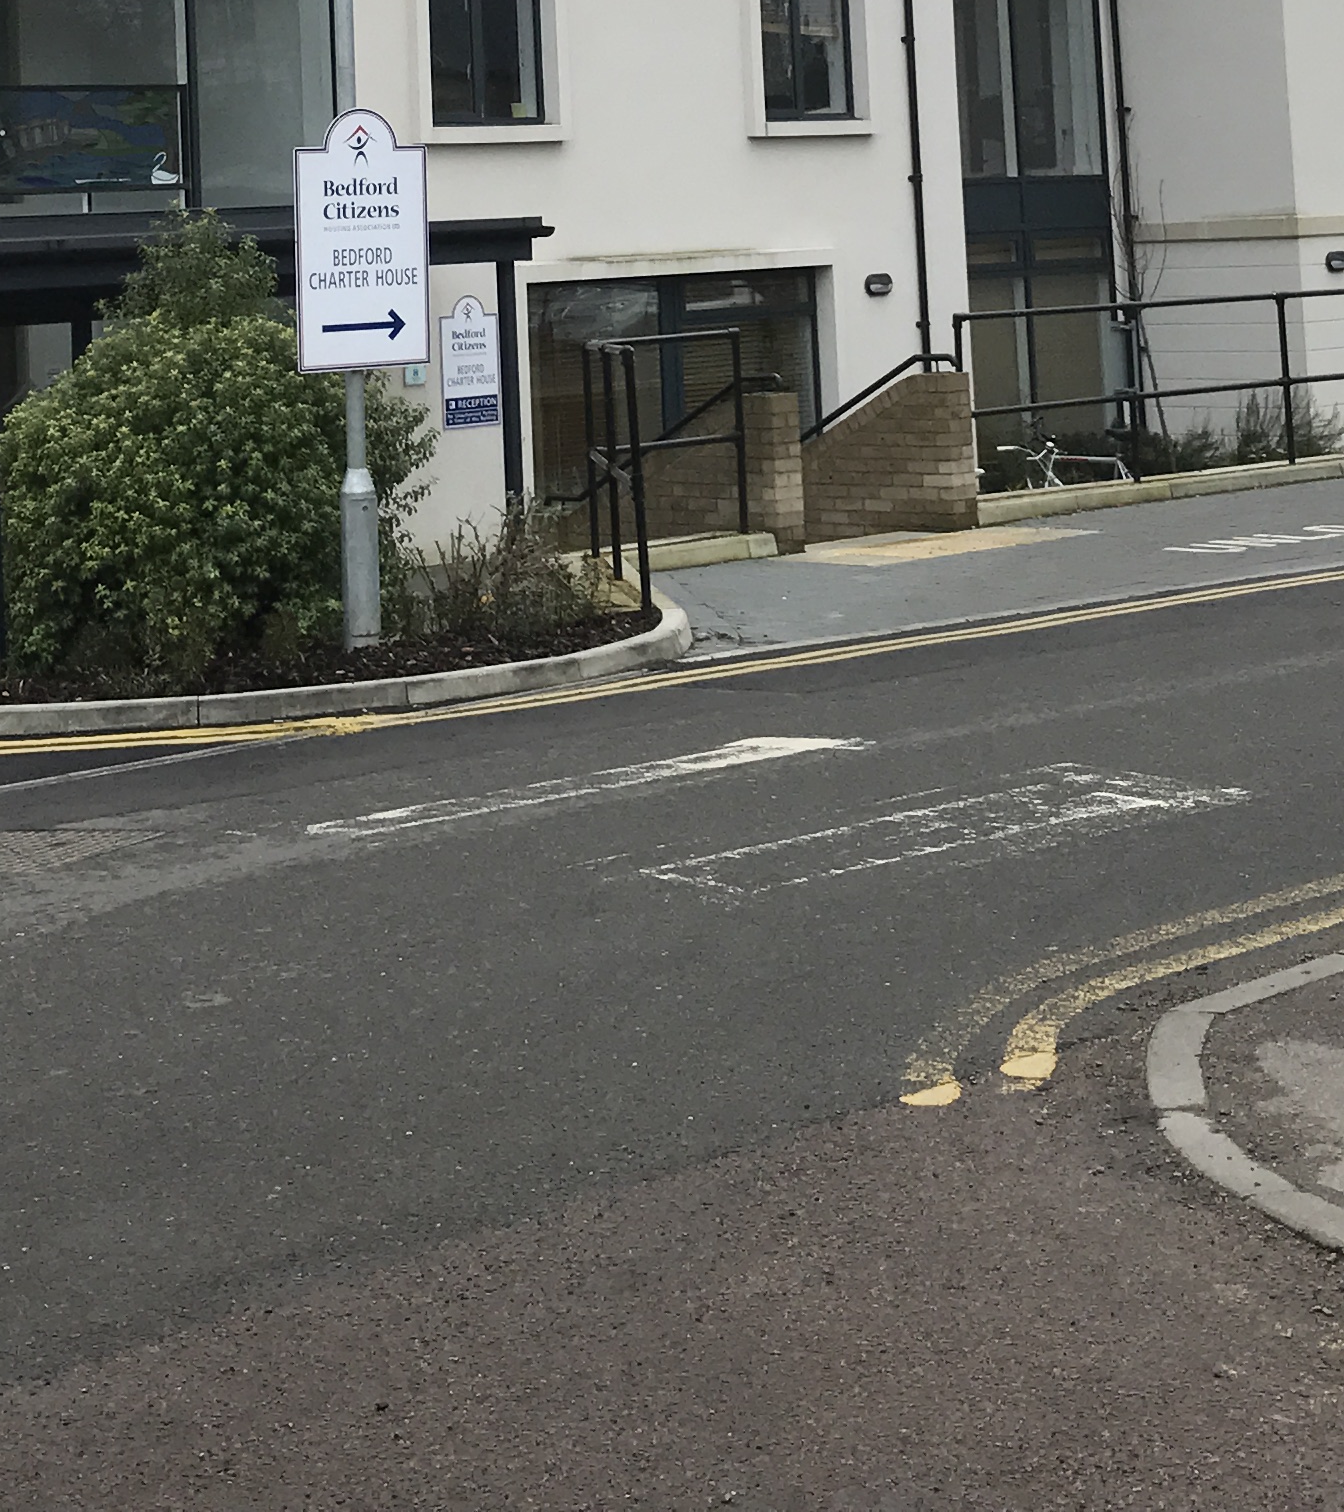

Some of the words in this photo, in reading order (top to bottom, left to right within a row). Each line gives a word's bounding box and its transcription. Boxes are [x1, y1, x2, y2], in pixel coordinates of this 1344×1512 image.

[323, 176, 399, 197] Bedford
[323, 201, 400, 220] Citizens
[333, 247, 393, 267] BEDFORD
[309, 270, 369, 290] CHARTER
[376, 267, 418, 286] HOUSE
[452, 328, 486, 340] Bedford
[452, 341, 487, 352] Citizens
[457, 363, 485, 375] BEDFORD
[447, 376, 475, 387] CHARTER
[476, 373, 496, 385] HOUSE
[457, 397, 497, 409] RECEPTION
